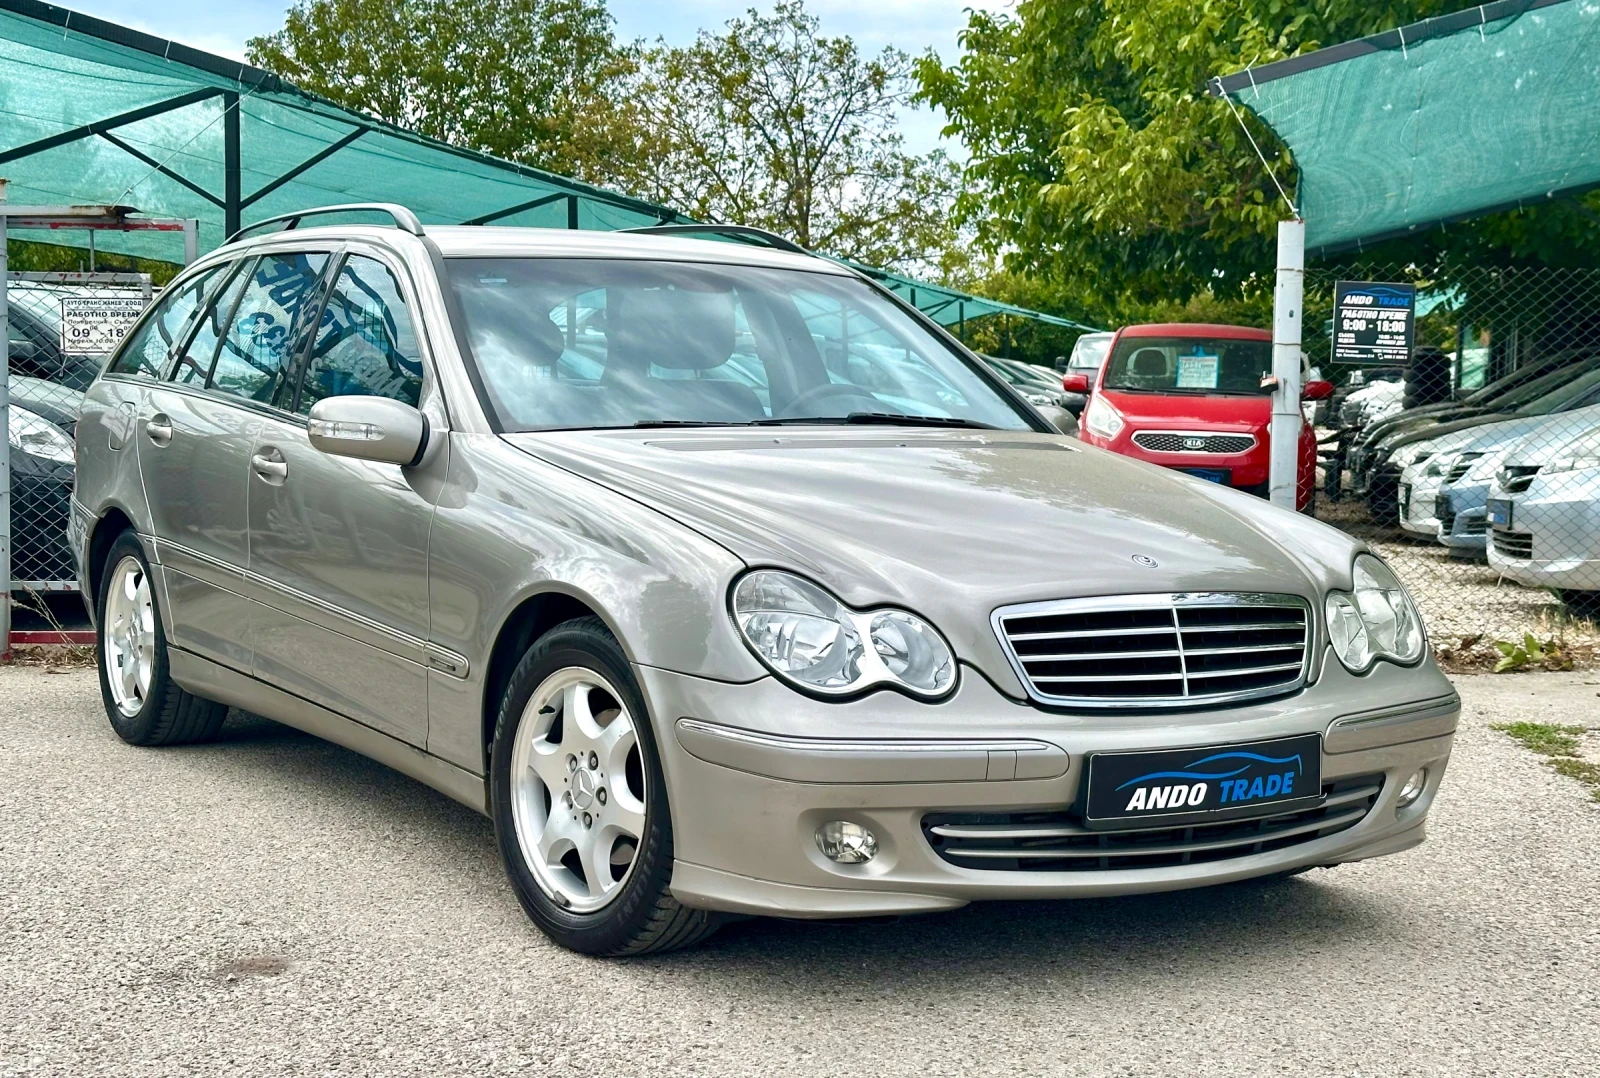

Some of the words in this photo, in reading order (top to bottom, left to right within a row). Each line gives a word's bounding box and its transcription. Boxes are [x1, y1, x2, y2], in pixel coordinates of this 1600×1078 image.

[1342, 295, 1373, 305] ANDO
[1378, 296, 1410, 306] TRADE
[1341, 310, 1378, 319] РАБОТНО
[1378, 311, 1408, 320] ВРЕМЕ
[1342, 319, 1366, 331] 9:00
[1376, 319, 1406, 333] 18:00
[1186, 439, 1202, 447] KIA
[1125, 782, 1208, 811] ANDO
[1220, 771, 1295, 803] TRADE
